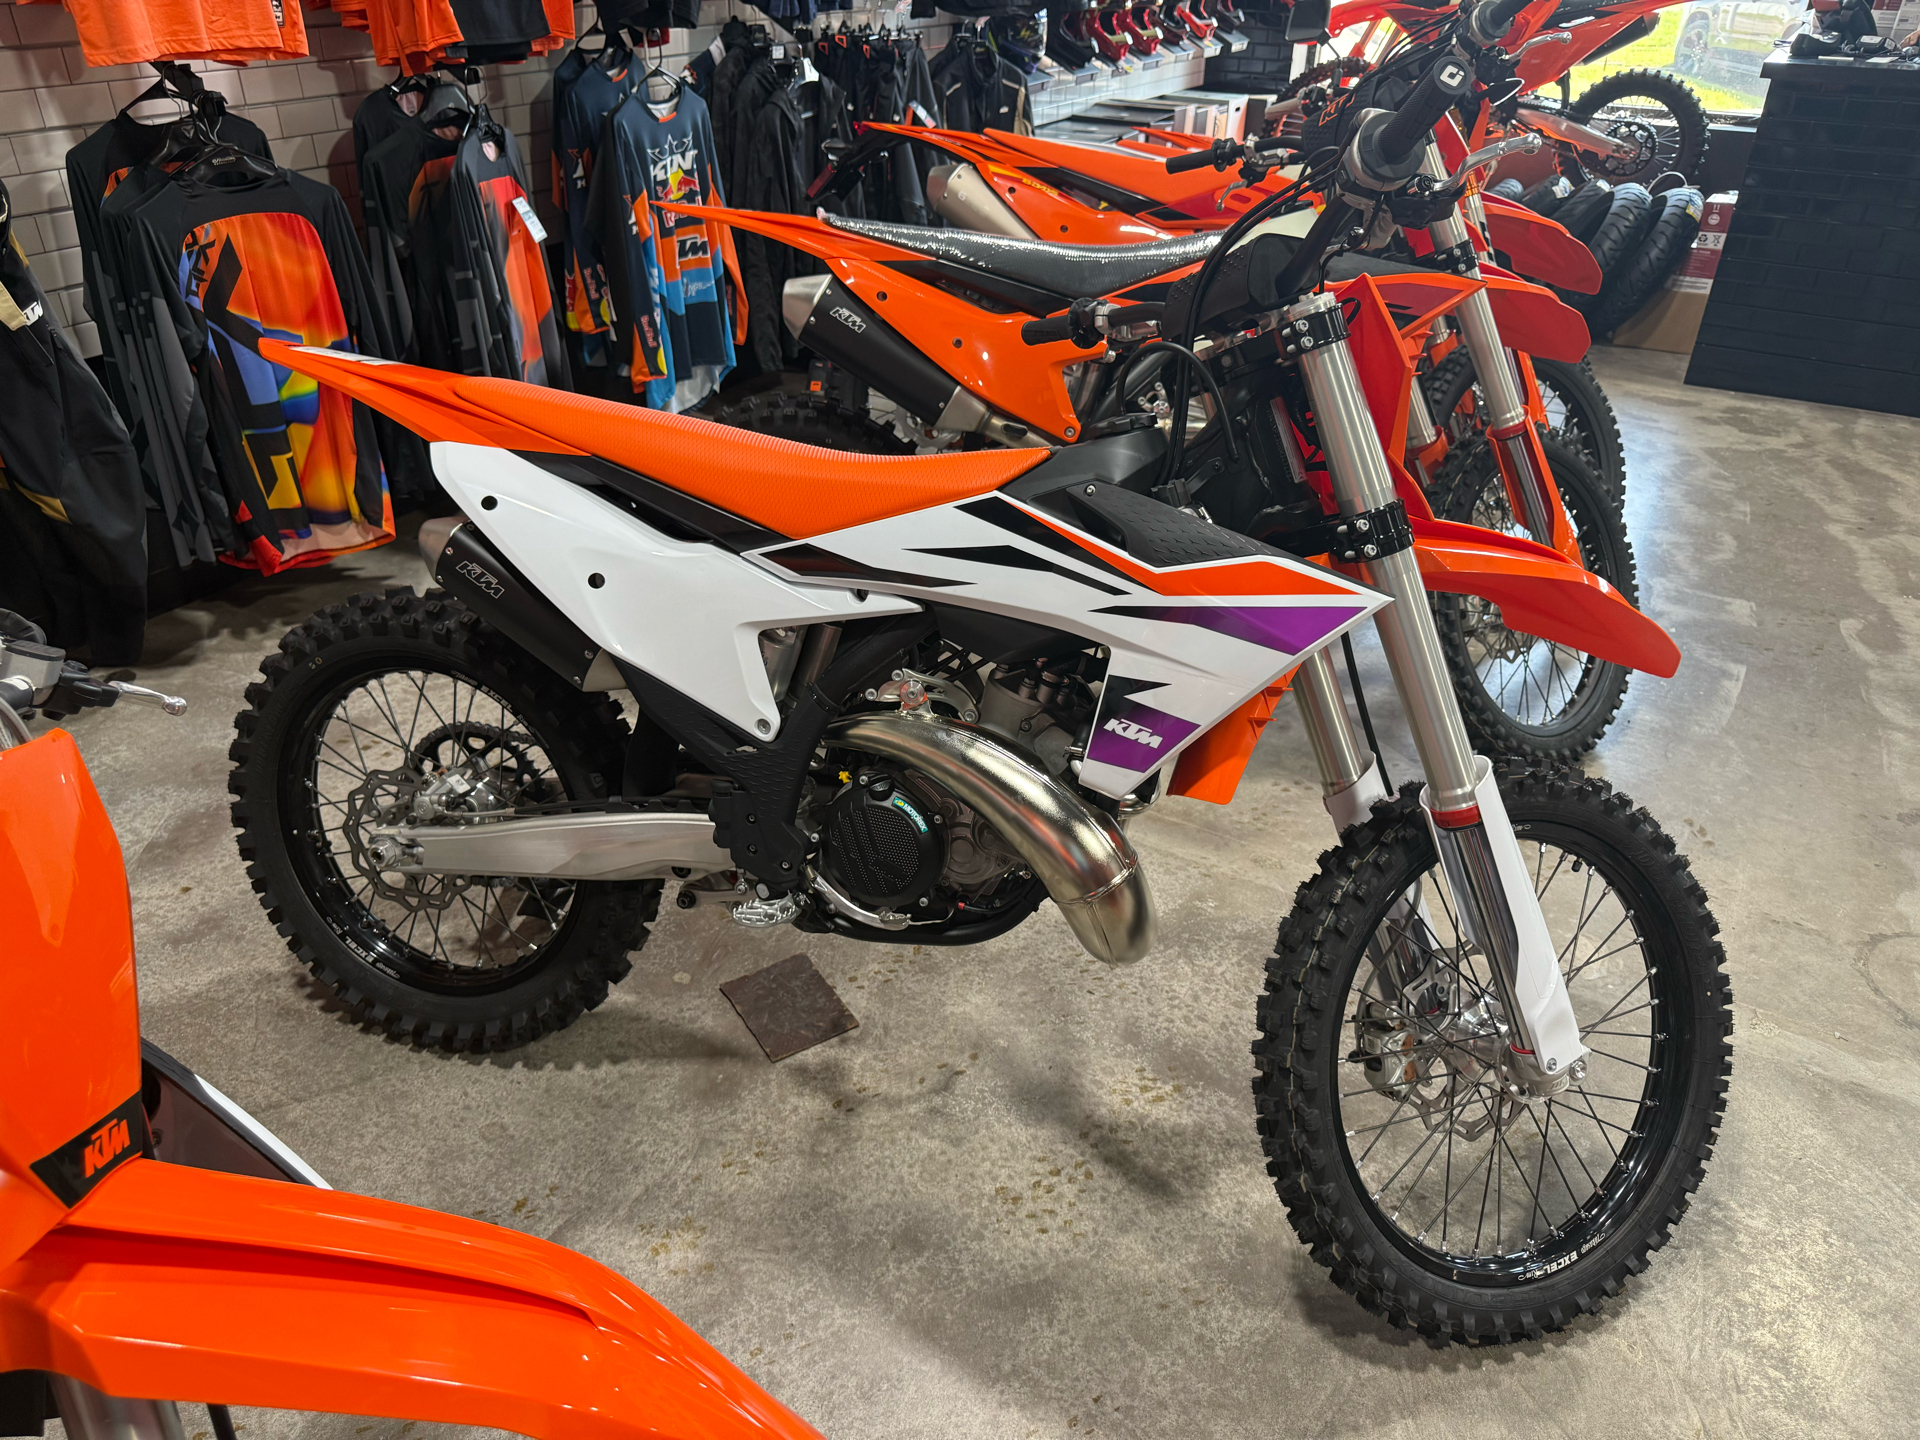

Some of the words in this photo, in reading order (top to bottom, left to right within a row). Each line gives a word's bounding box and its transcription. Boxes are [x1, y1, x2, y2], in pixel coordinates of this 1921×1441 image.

[829, 306, 867, 334] KTM
[455, 560, 505, 599] KTM
[1103, 717, 1164, 749] KTM
[84, 1117, 131, 1179] KTM
[1543, 1250, 1579, 1275] EXCEL
